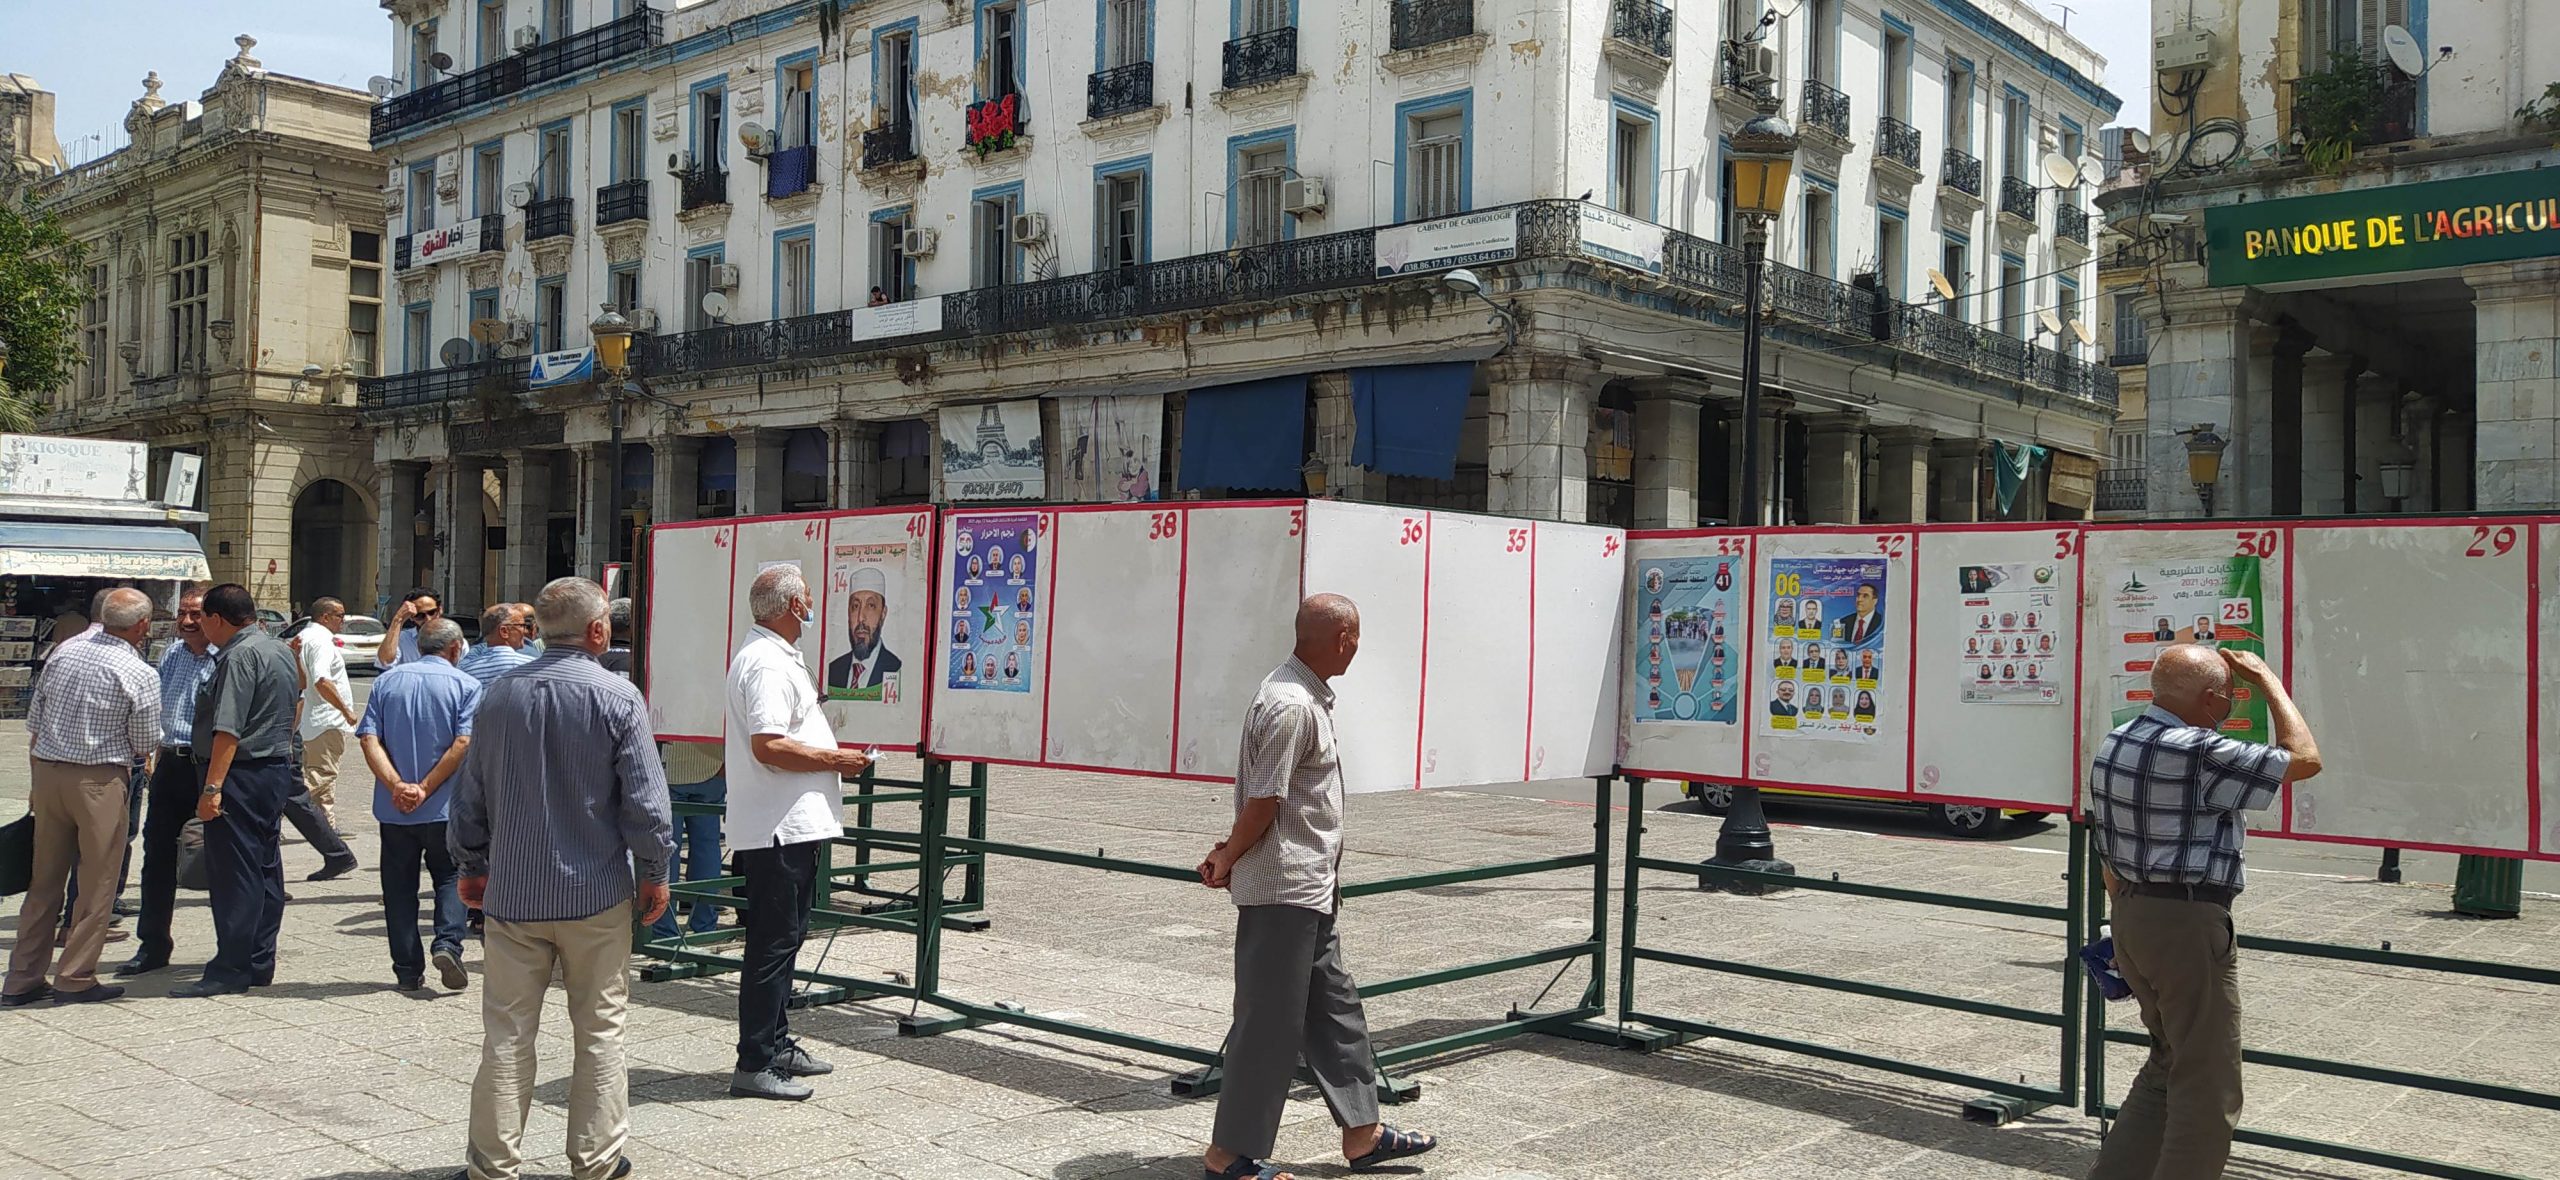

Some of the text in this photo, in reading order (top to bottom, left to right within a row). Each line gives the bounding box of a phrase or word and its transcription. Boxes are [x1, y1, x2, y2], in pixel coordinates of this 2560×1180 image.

[1417, 211, 1513, 233] CABINET DE CARDIOLOGIE
[1583, 207, 1632, 232] عيادة طبية
[2245, 220, 2358, 259] BANQUE
[2366, 215, 2405, 248] DE
[1404, 257, 1452, 272] 038.86.17.19
[1458, 249, 1514, 264] 0553.64.61.22
[27, 441, 102, 458] KIOSQUE
[804, 520, 822, 542] 41
[906, 513, 927, 540] 40
[1150, 511, 1178, 540] 38
[1400, 518, 1423, 545] 36
[714, 528, 731, 549] 42
[958, 537, 972, 552] 50
[1506, 529, 1528, 553] 35
[1602, 535, 1620, 558] 34
[1718, 537, 1745, 559] 33
[1875, 535, 1906, 558] 32
[2234, 530, 2278, 559] 30
[2464, 526, 2517, 558] 29
[27, 552, 78, 567] Kiosque
[864, 546, 887, 556] العدالة
[889, 547, 906, 558] جبهة
[834, 571, 848, 593] 14
[1716, 574, 1729, 587] 41
[2160, 565, 2205, 577] التشريعية
[1775, 573, 1801, 597] 06
[2181, 578, 2199, 587] 2021
[2223, 602, 2250, 620] 25
[883, 681, 898, 705] 14
[2041, 688, 2052, 698] 16
